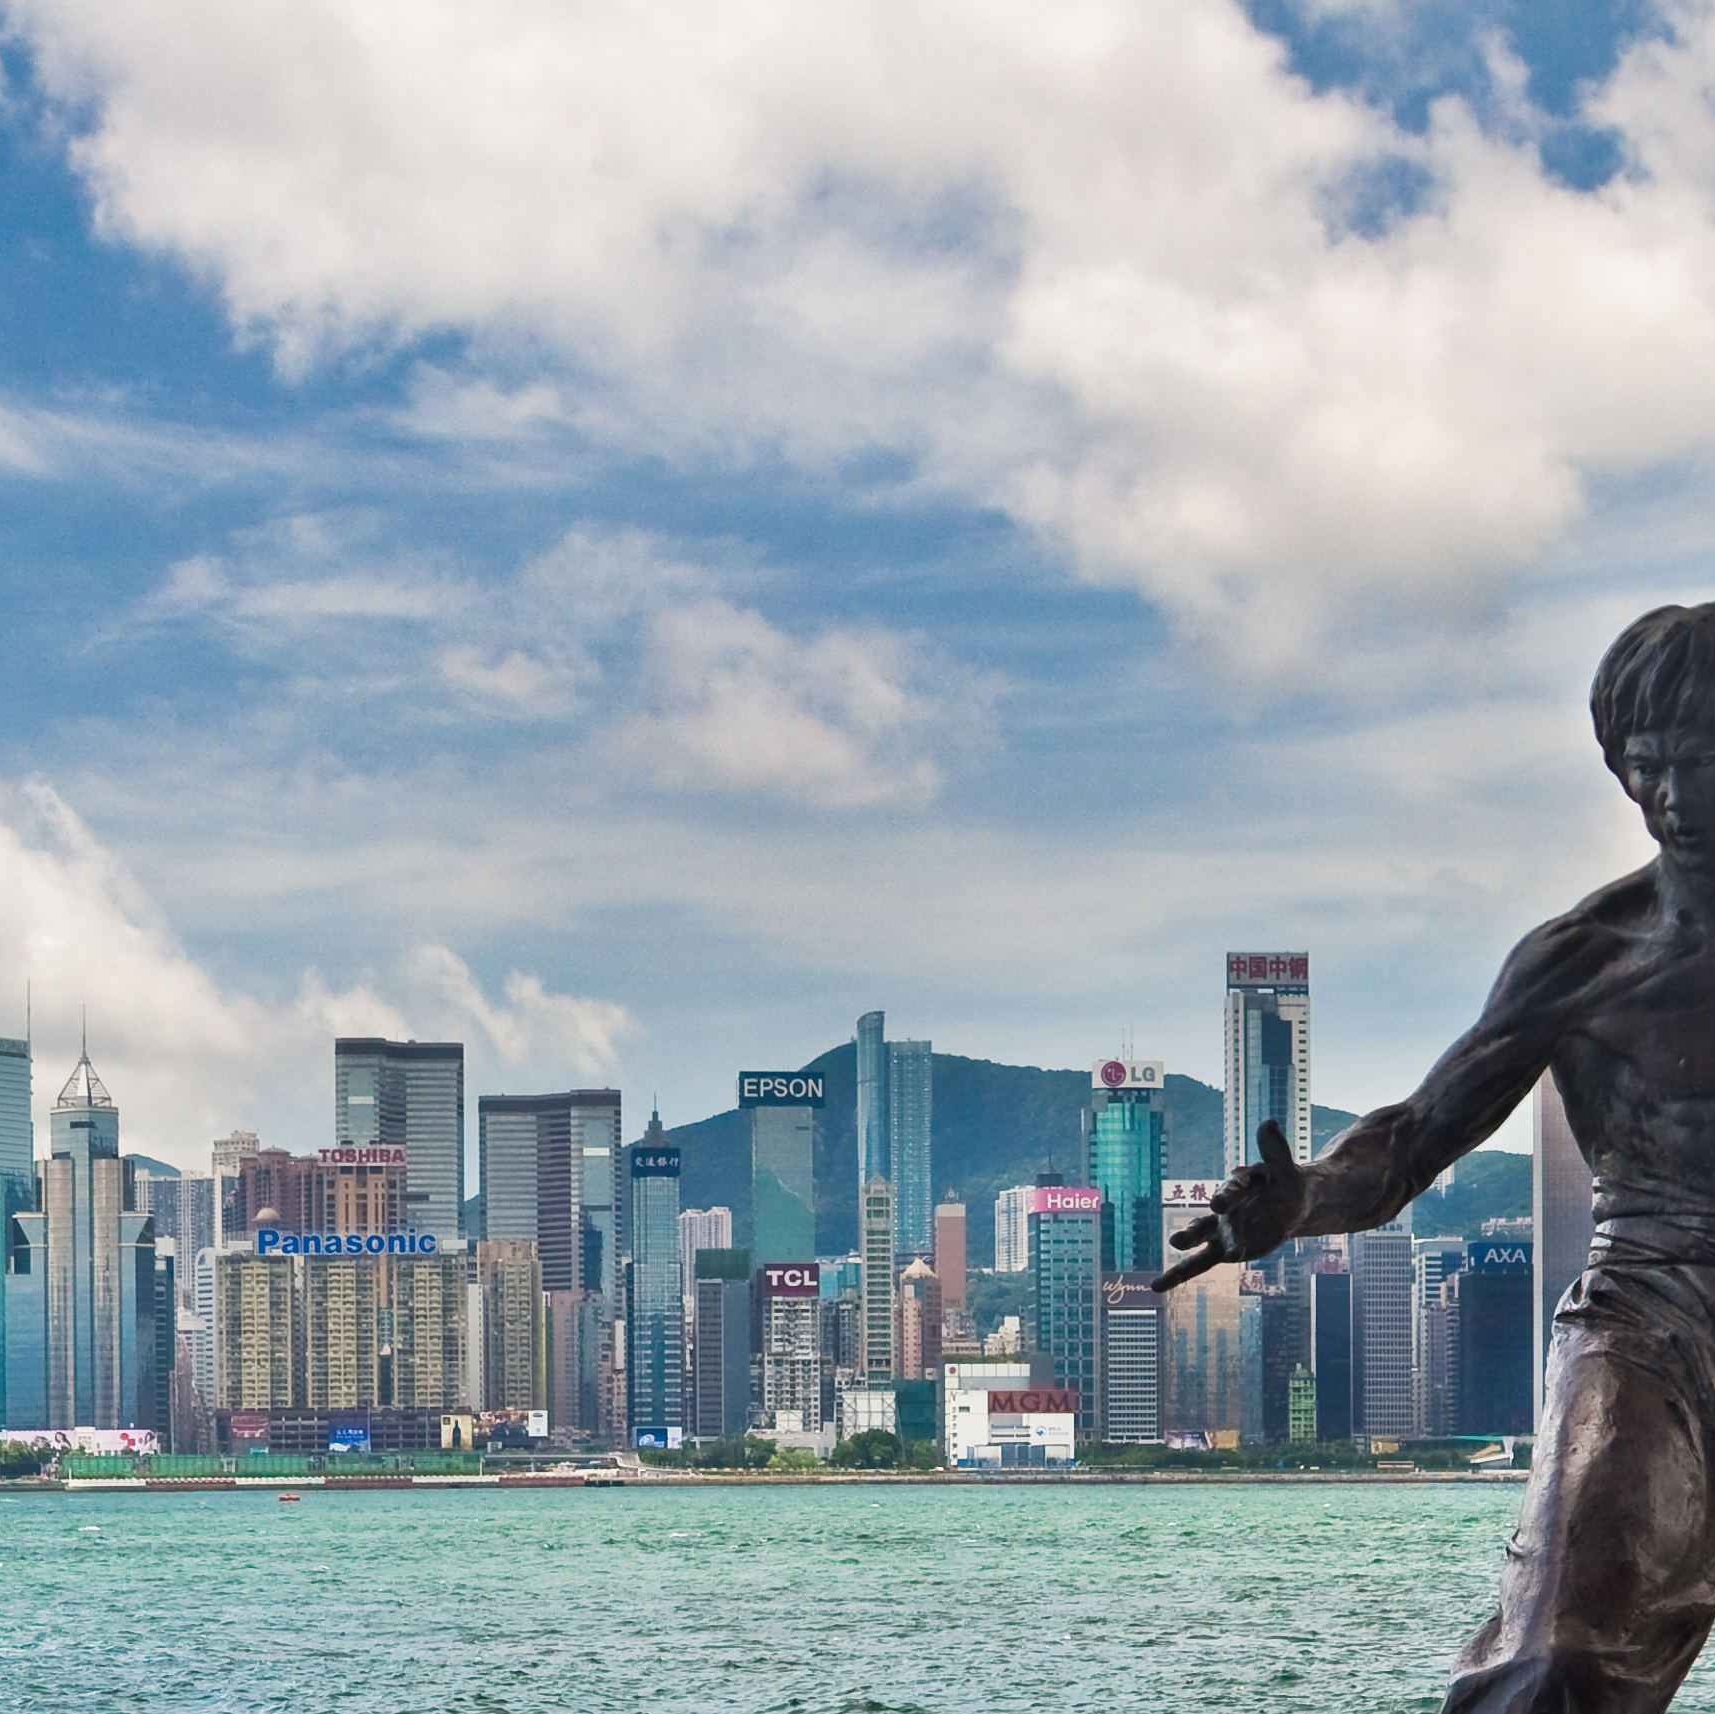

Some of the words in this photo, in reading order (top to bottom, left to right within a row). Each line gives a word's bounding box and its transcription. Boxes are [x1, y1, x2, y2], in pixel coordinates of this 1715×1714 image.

[1229, 955, 1308, 980] 中国中钢
[1130, 1066, 1156, 1082] LG
[743, 1078, 823, 1098] EPSON
[318, 1148, 406, 1164] TOSHIBA
[1046, 1193, 1100, 1209] Haier
[257, 1228, 437, 1255] Panasonic
[1483, 1248, 1527, 1264] AXA
[766, 1269, 818, 1287] TCL
[990, 1392, 1073, 1413] MGM
